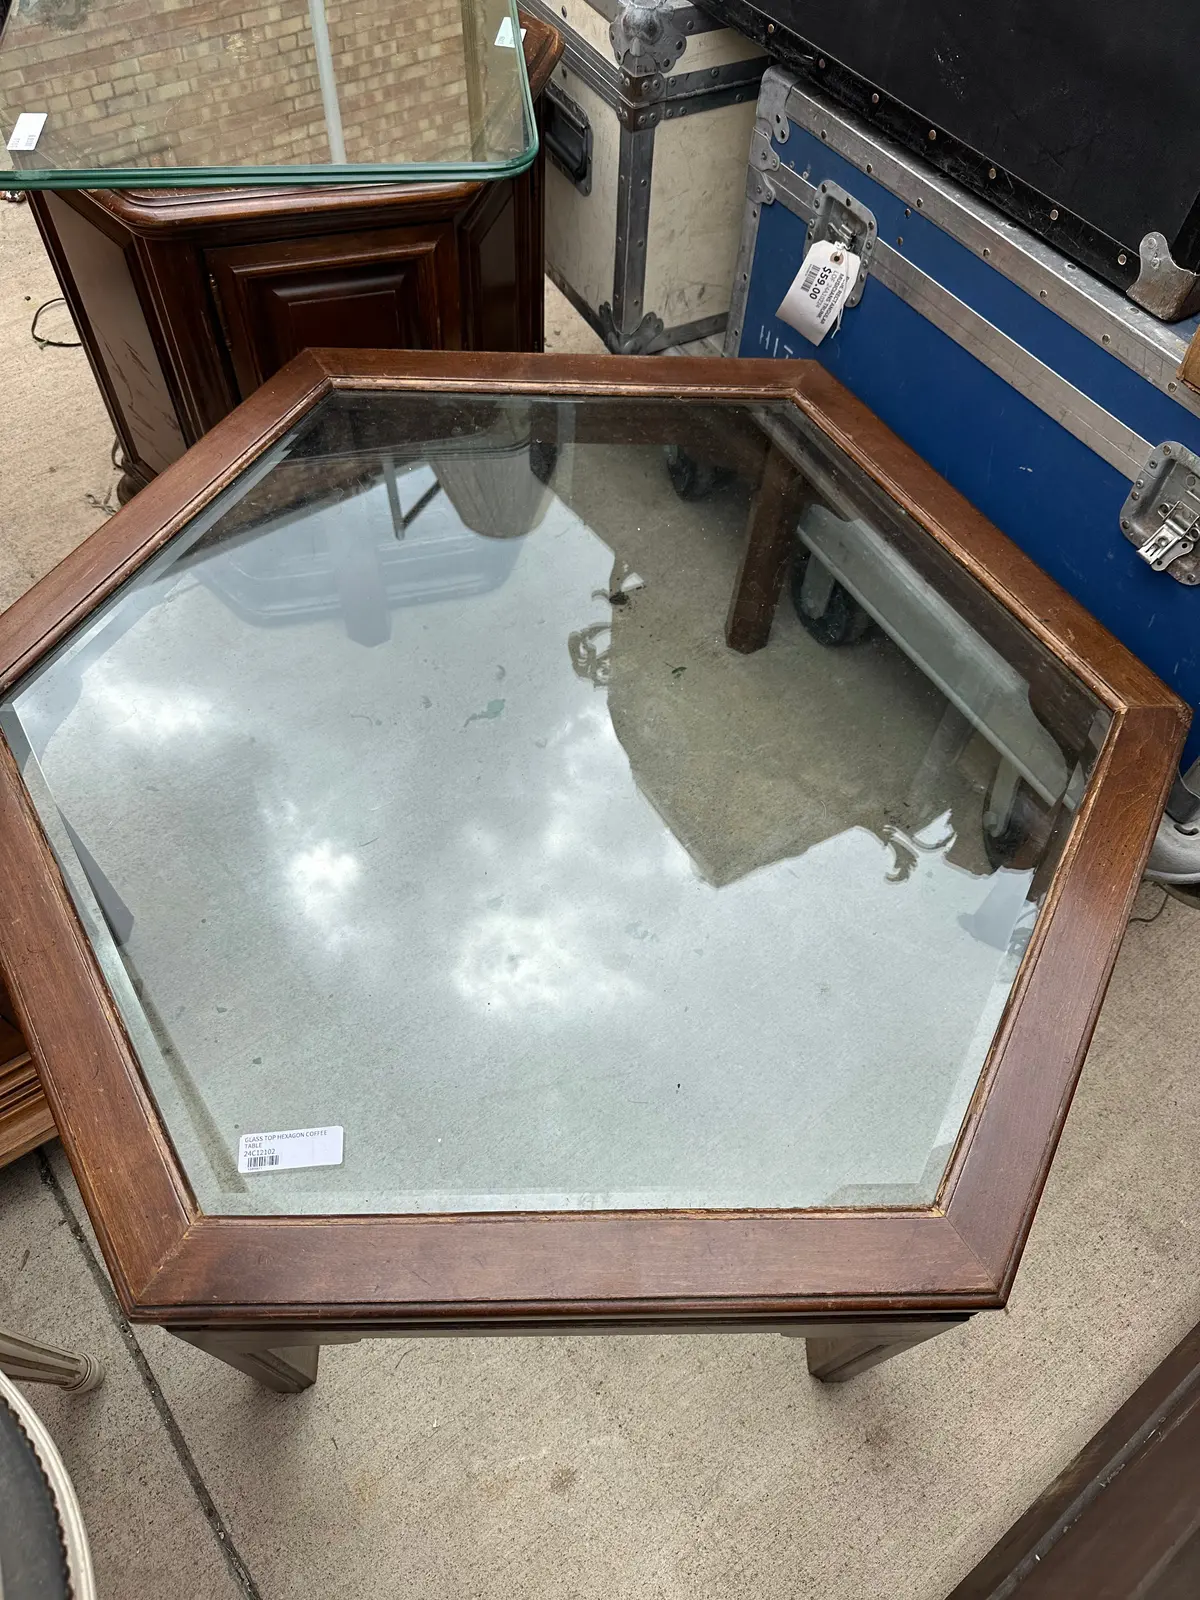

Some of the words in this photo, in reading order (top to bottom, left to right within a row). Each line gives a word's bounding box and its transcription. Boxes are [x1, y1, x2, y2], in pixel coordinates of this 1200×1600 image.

[808, 266, 832, 301] $59.00
[826, 273, 845, 303] MUSICIANS
[817, 302, 828, 319] TRUNK
[820, 289, 842, 325] RECTANGULAR
[277, 1132, 305, 1140] HEXAGON
[244, 1149, 276, 1157] 24C12102
